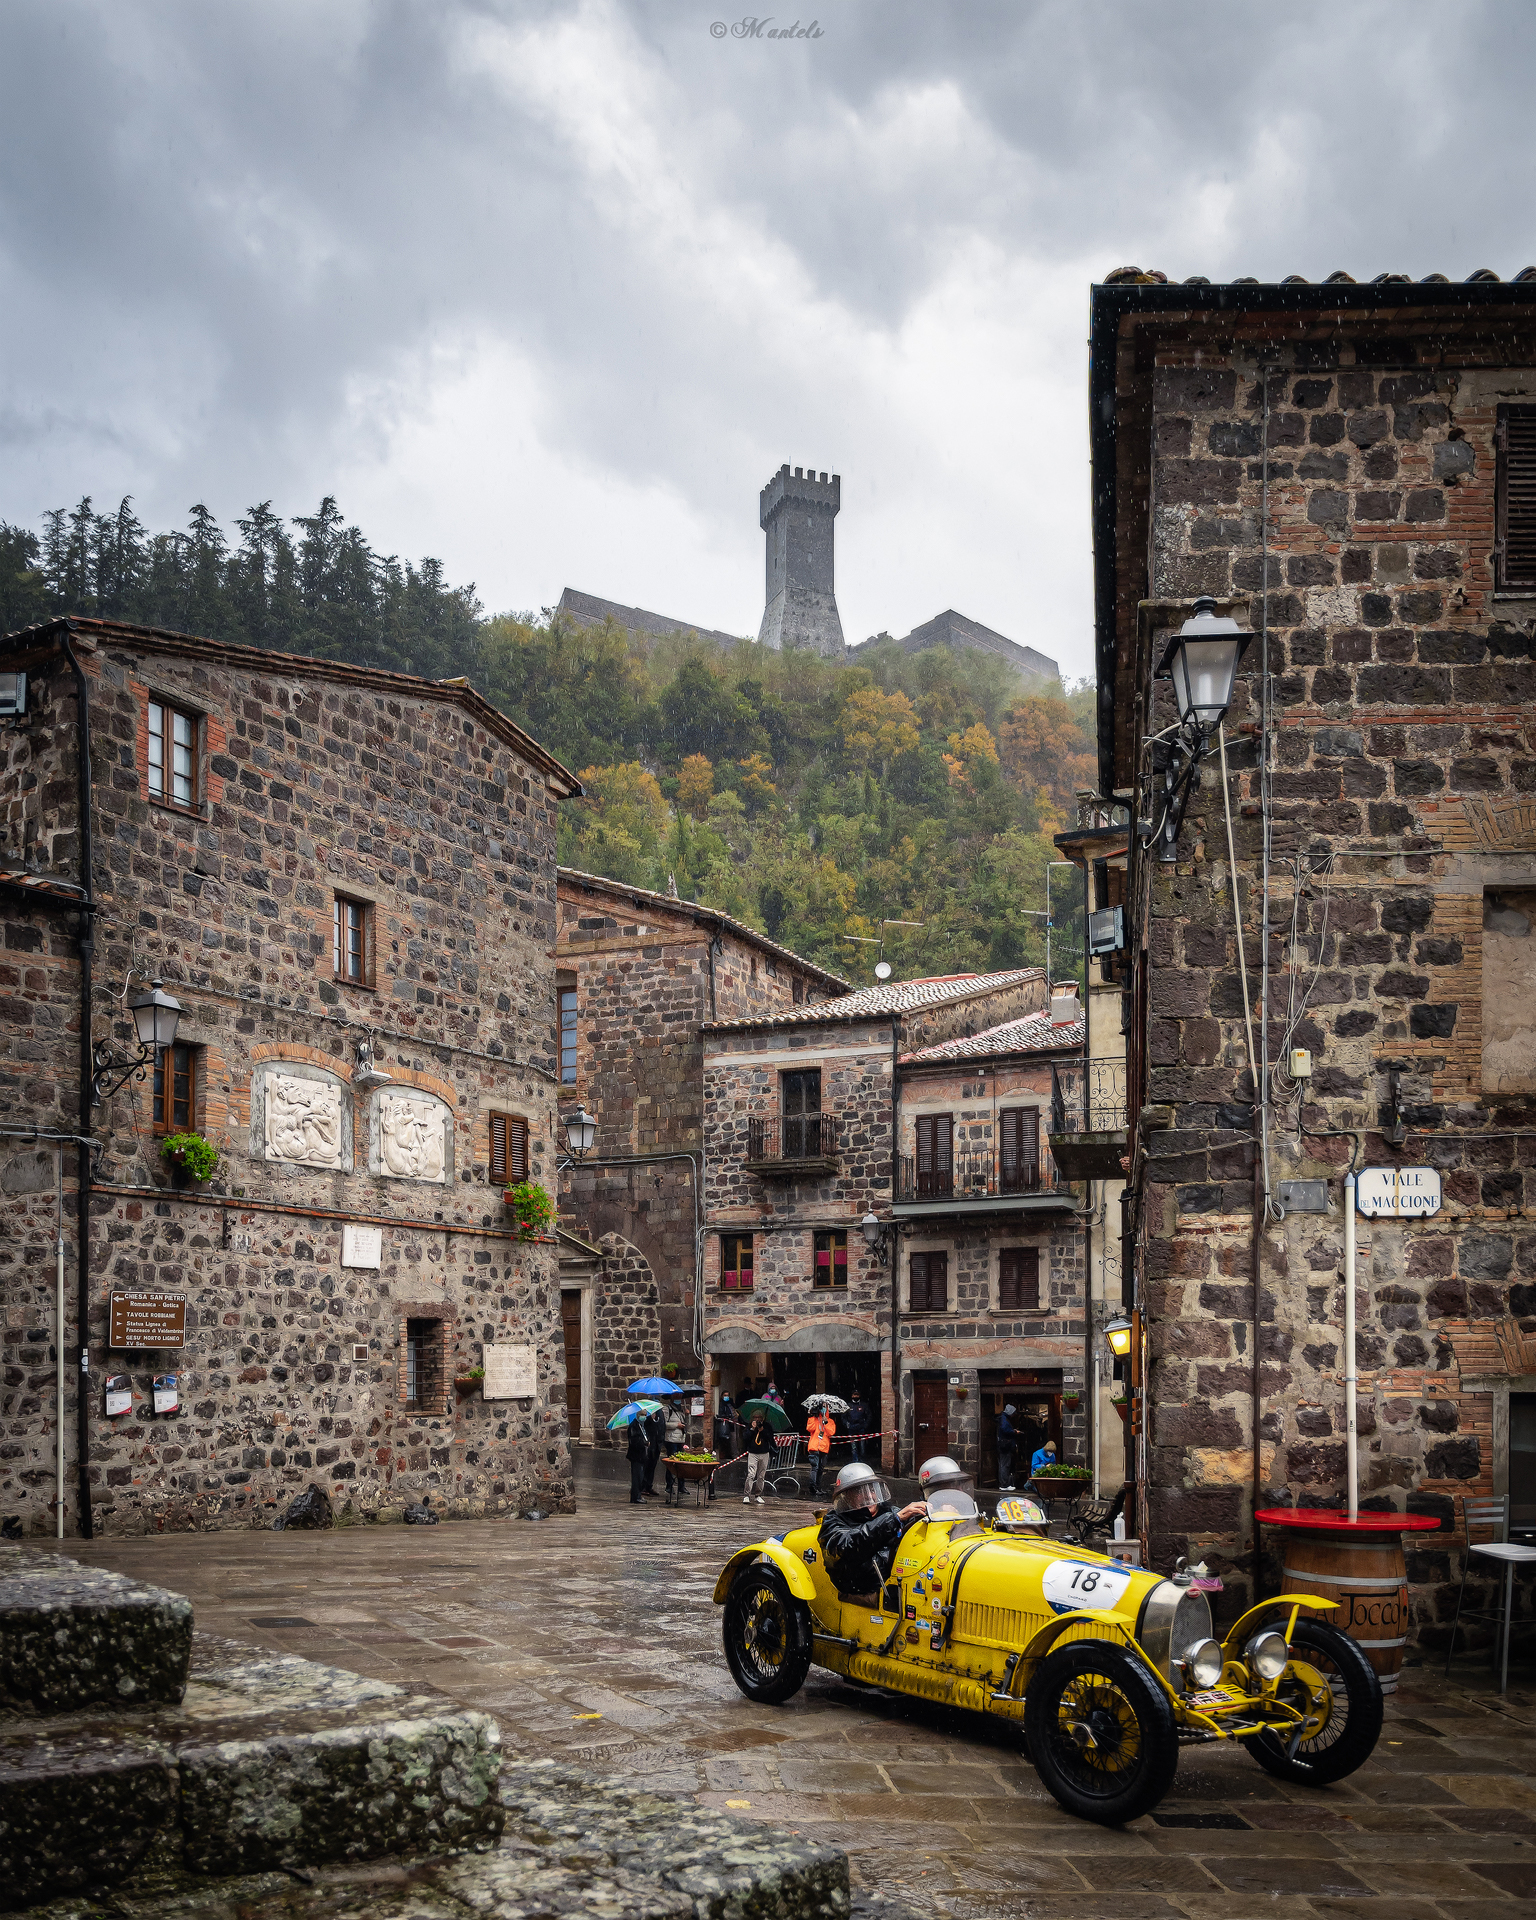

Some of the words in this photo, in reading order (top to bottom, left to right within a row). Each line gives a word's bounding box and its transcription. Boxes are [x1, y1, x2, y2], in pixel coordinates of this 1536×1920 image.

[1382, 1173, 1423, 1187] VIALE
[1360, 1199, 1371, 1208] DEL
[1372, 1195, 1439, 1208] MACCIONE
[1001, 1501, 1025, 1521] 18
[1071, 1568, 1101, 1592] 18
